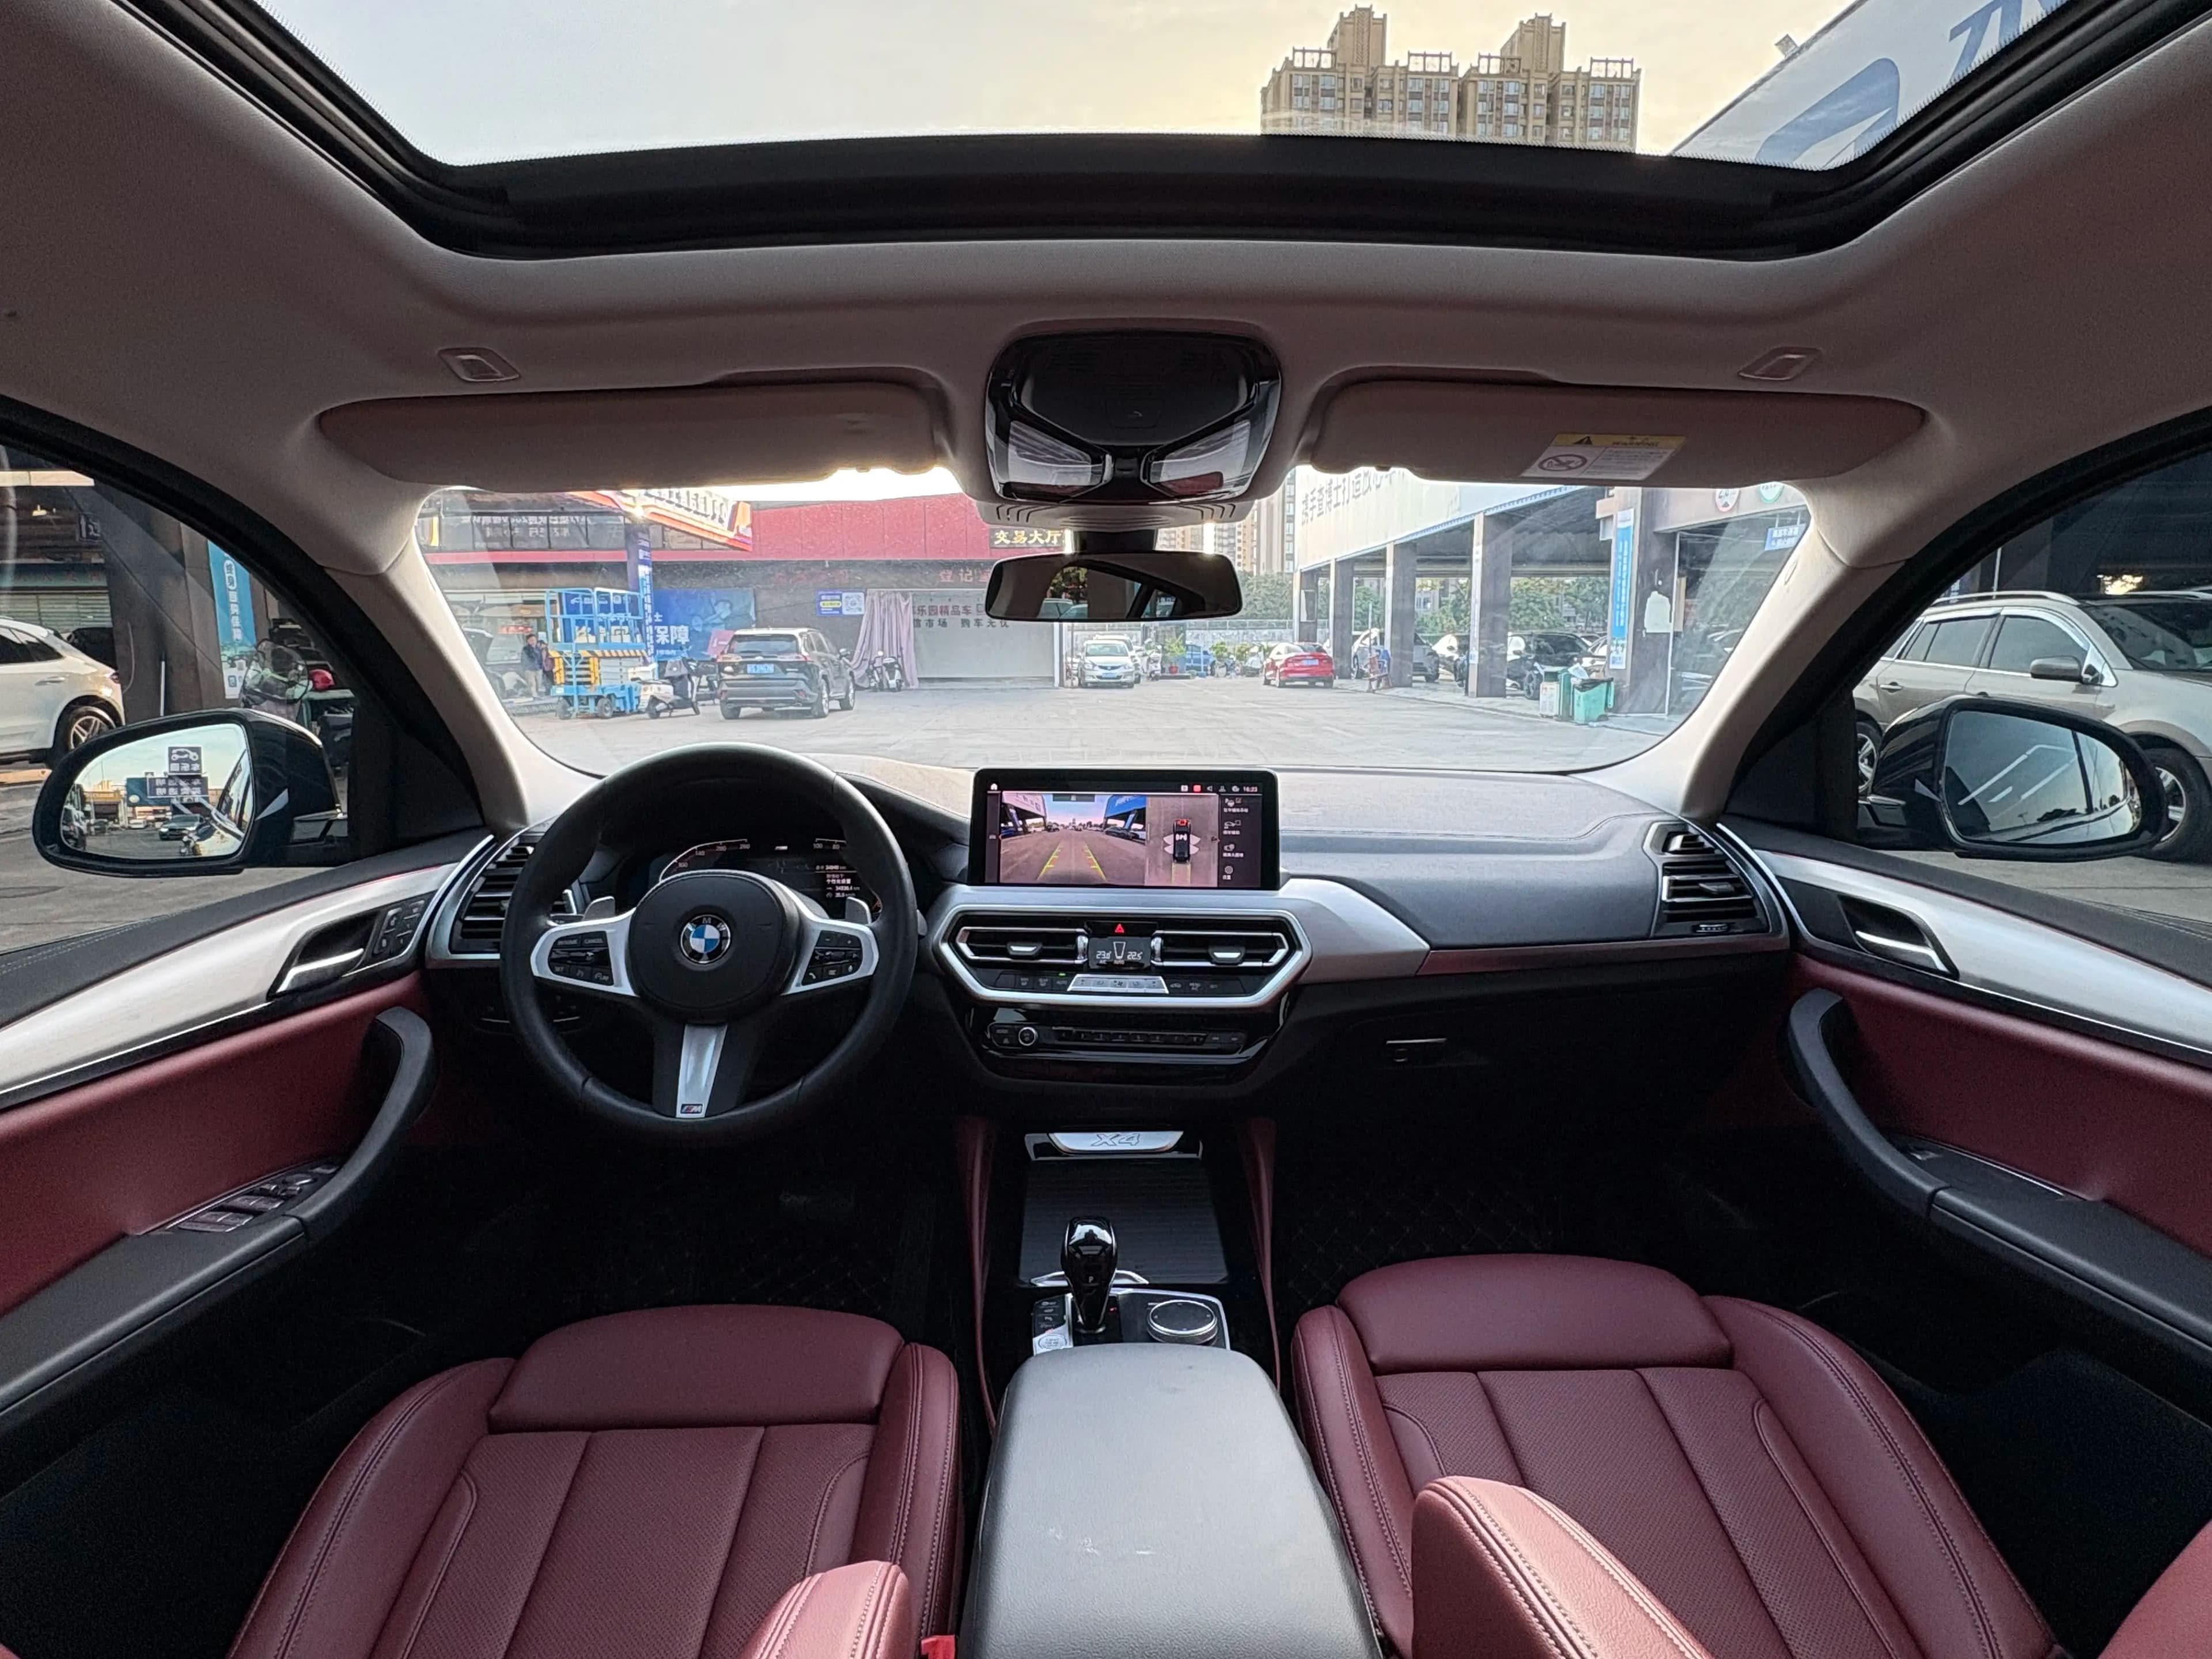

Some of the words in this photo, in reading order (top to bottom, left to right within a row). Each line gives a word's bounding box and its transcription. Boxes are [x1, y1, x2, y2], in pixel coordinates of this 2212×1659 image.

[994, 530, 1062, 545] 交易大厅
[913, 605, 972, 617] 乐园精品车
[654, 625, 690, 645] 保障
[686, 917, 726, 931] BMW
[1090, 1132, 1140, 1146] X4
